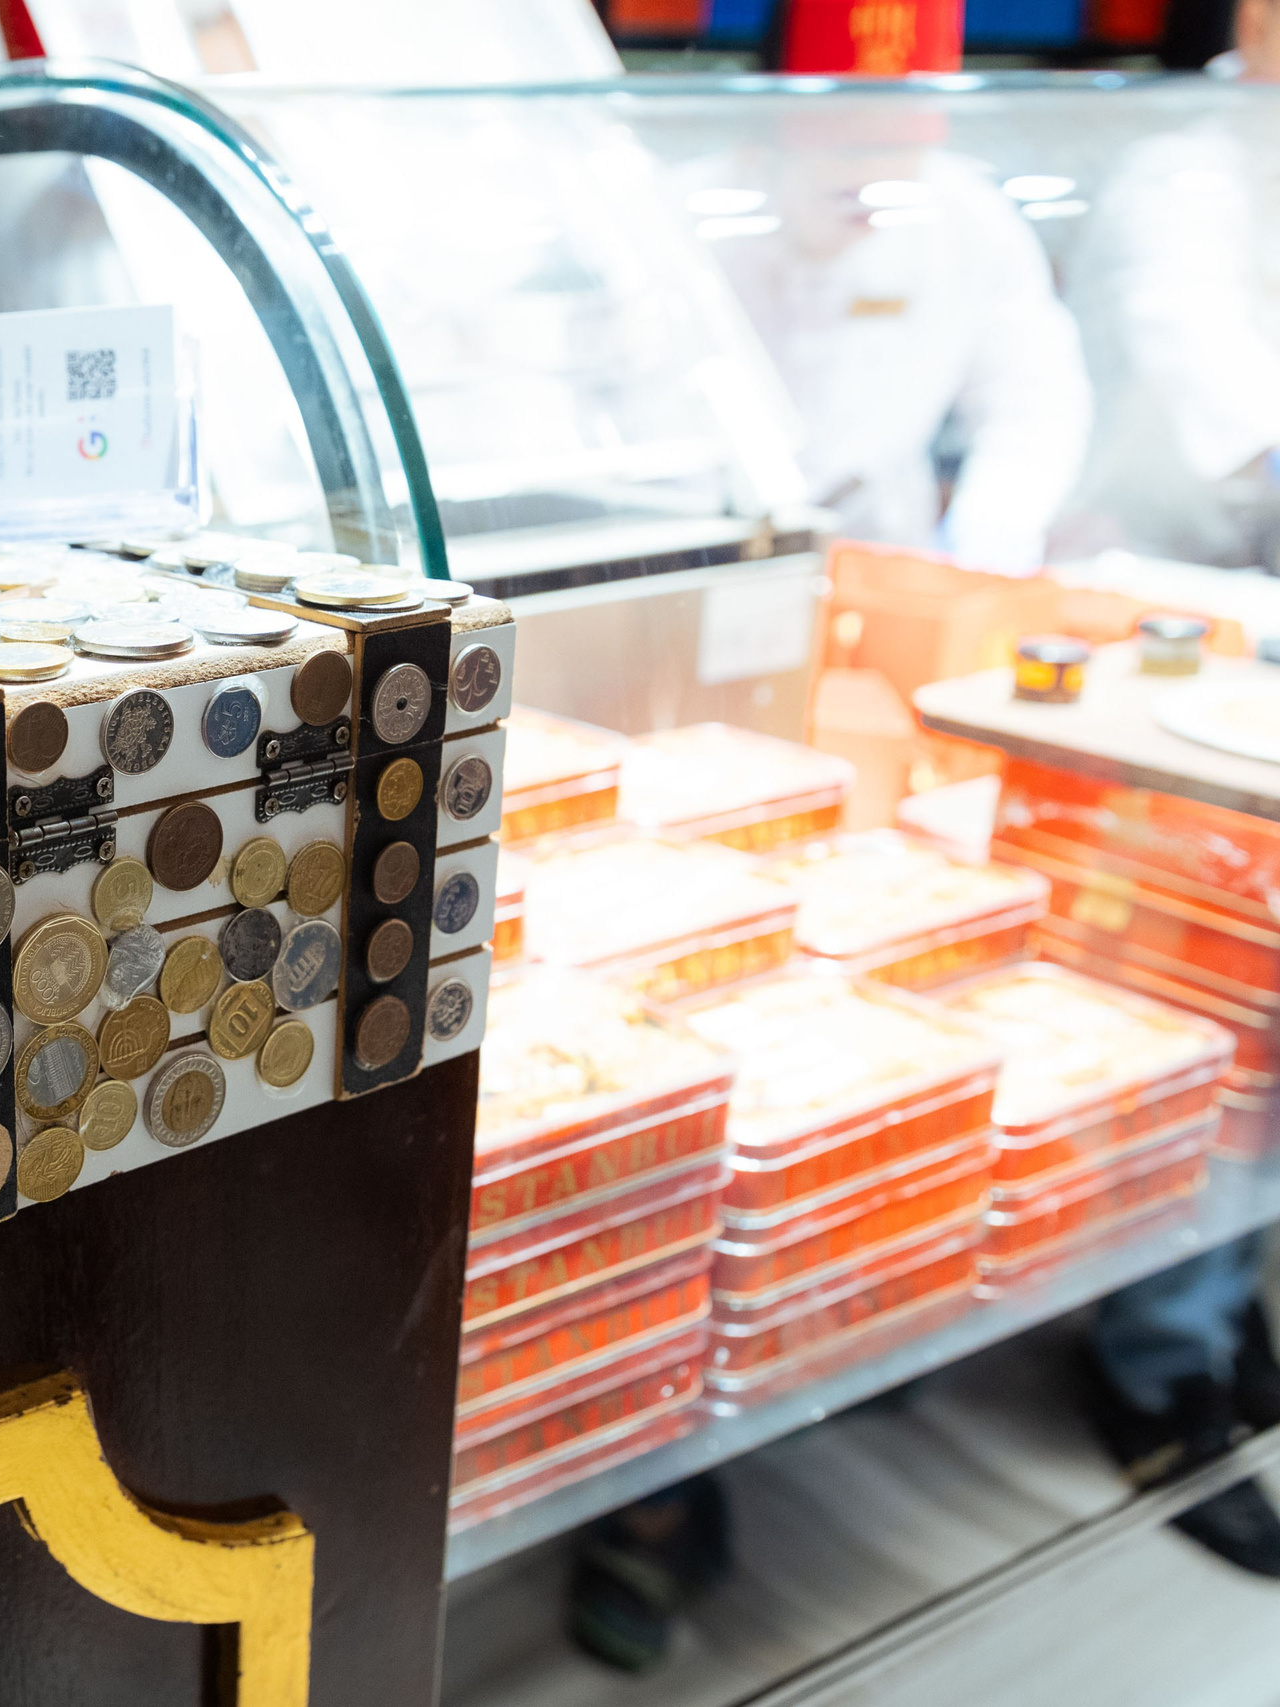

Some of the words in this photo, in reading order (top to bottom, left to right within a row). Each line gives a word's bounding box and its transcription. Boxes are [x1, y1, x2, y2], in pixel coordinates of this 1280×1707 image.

[19, 942, 41, 995] COLOMBIA
[31, 968, 60, 1005] 1000
[227, 1001, 258, 1035] 10
